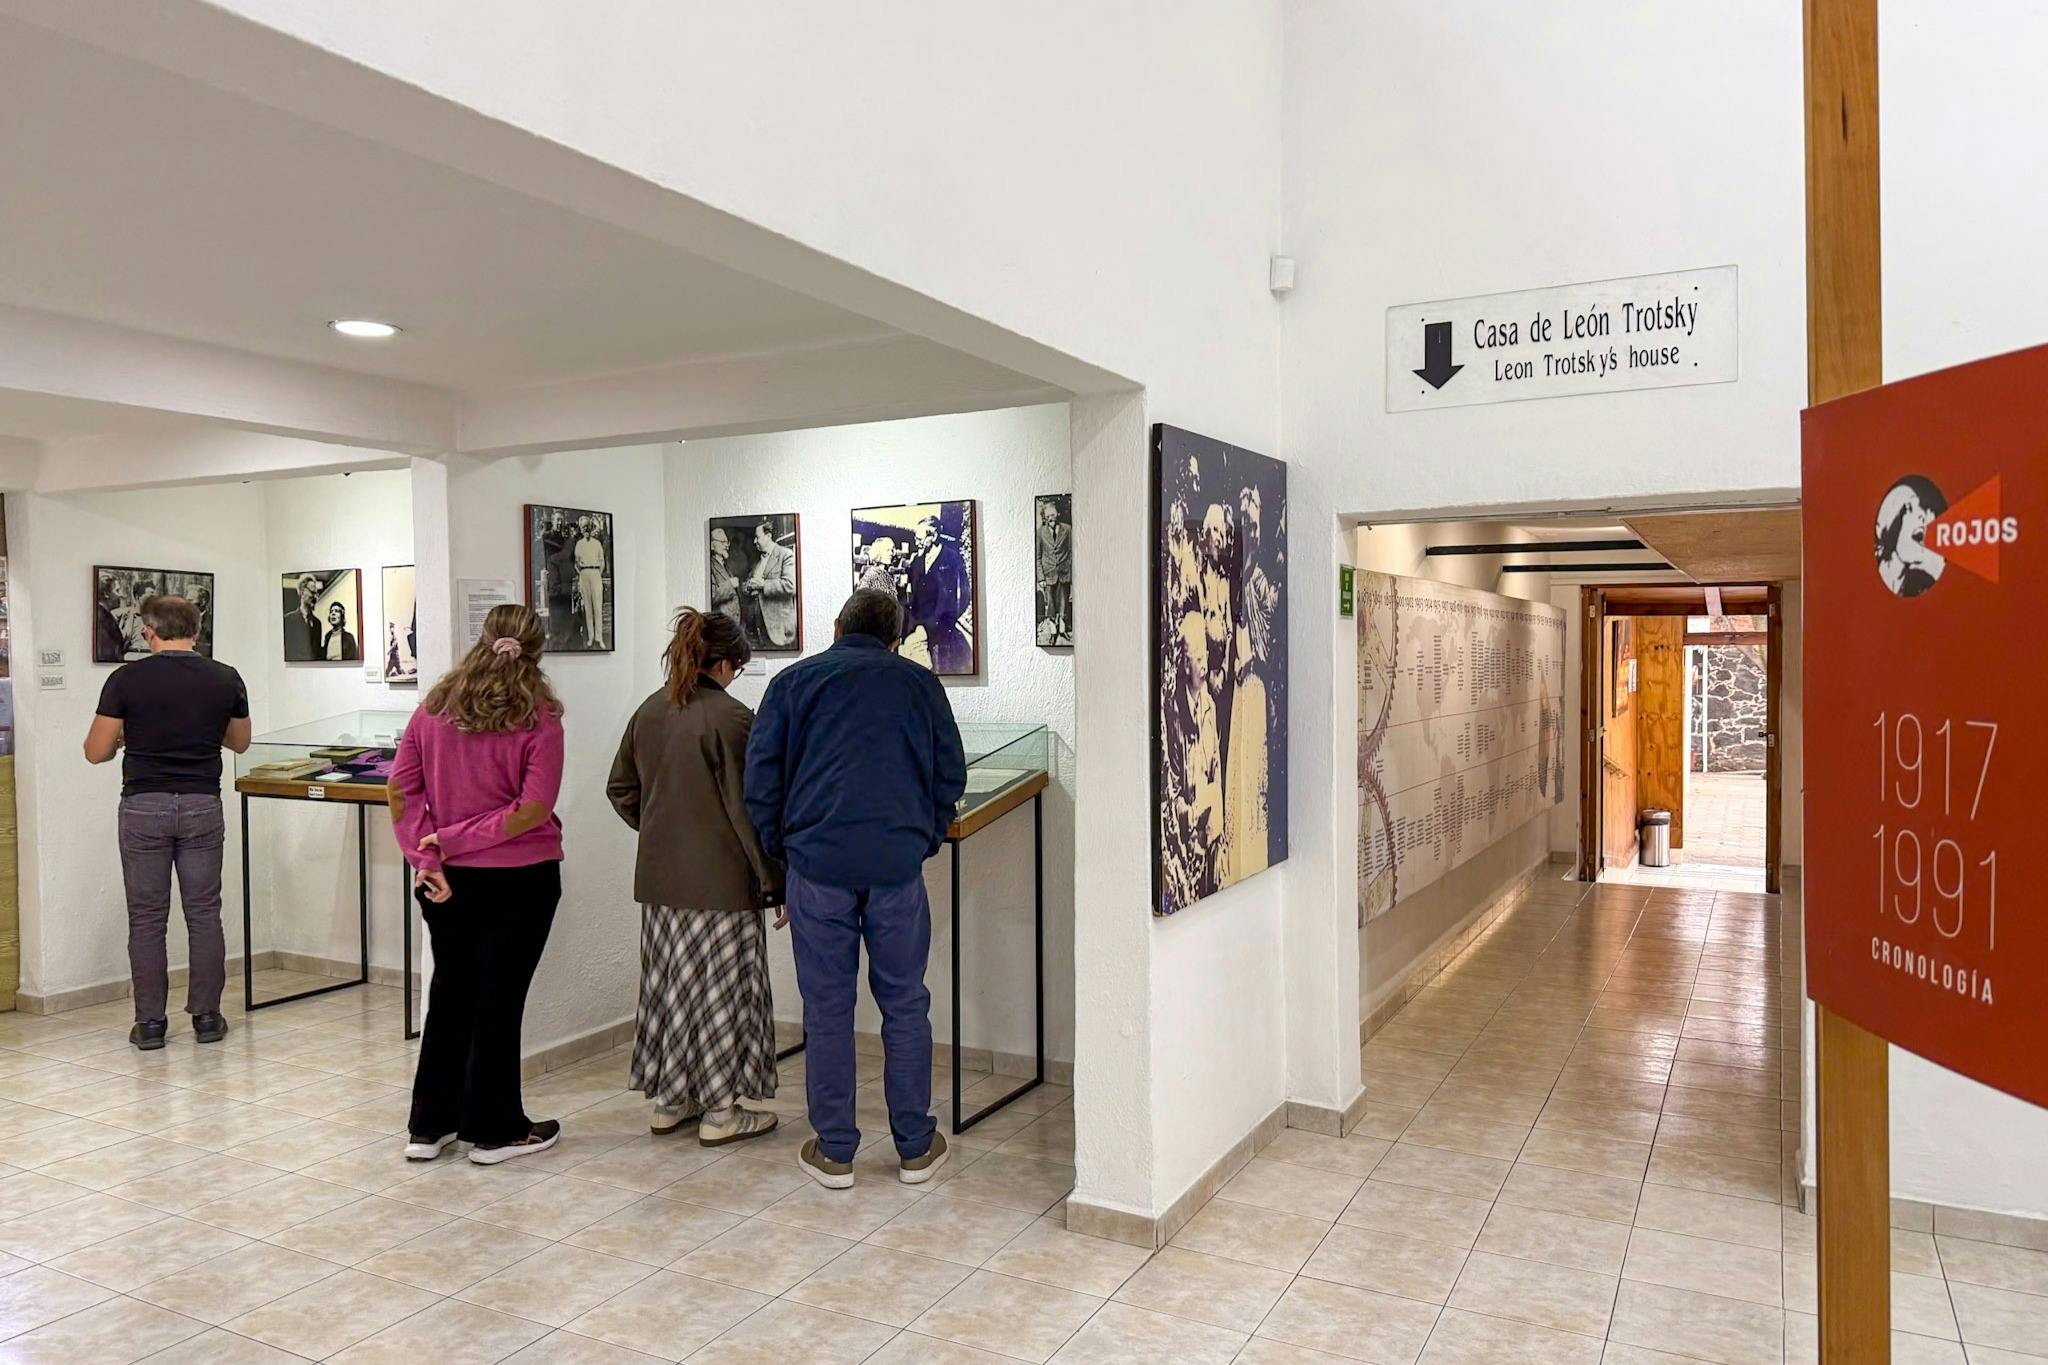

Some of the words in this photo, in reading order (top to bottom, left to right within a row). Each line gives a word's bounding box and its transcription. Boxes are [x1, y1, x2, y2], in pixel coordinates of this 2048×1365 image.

[1474, 319, 1519, 349] Casa
[1530, 311, 1552, 343] de
[1563, 303, 1610, 340] León
[1622, 296, 1698, 337] Trotsky
[1495, 359, 1533, 382] Leon
[1543, 345, 1618, 378] Trotsky's
[1629, 345, 1680, 369] house
[1936, 516, 2018, 547] ROJOS
[1873, 711, 1998, 821] 1917
[1872, 823, 1996, 951] 1991
[1871, 936, 1993, 1005] CRONOLOGÍA
